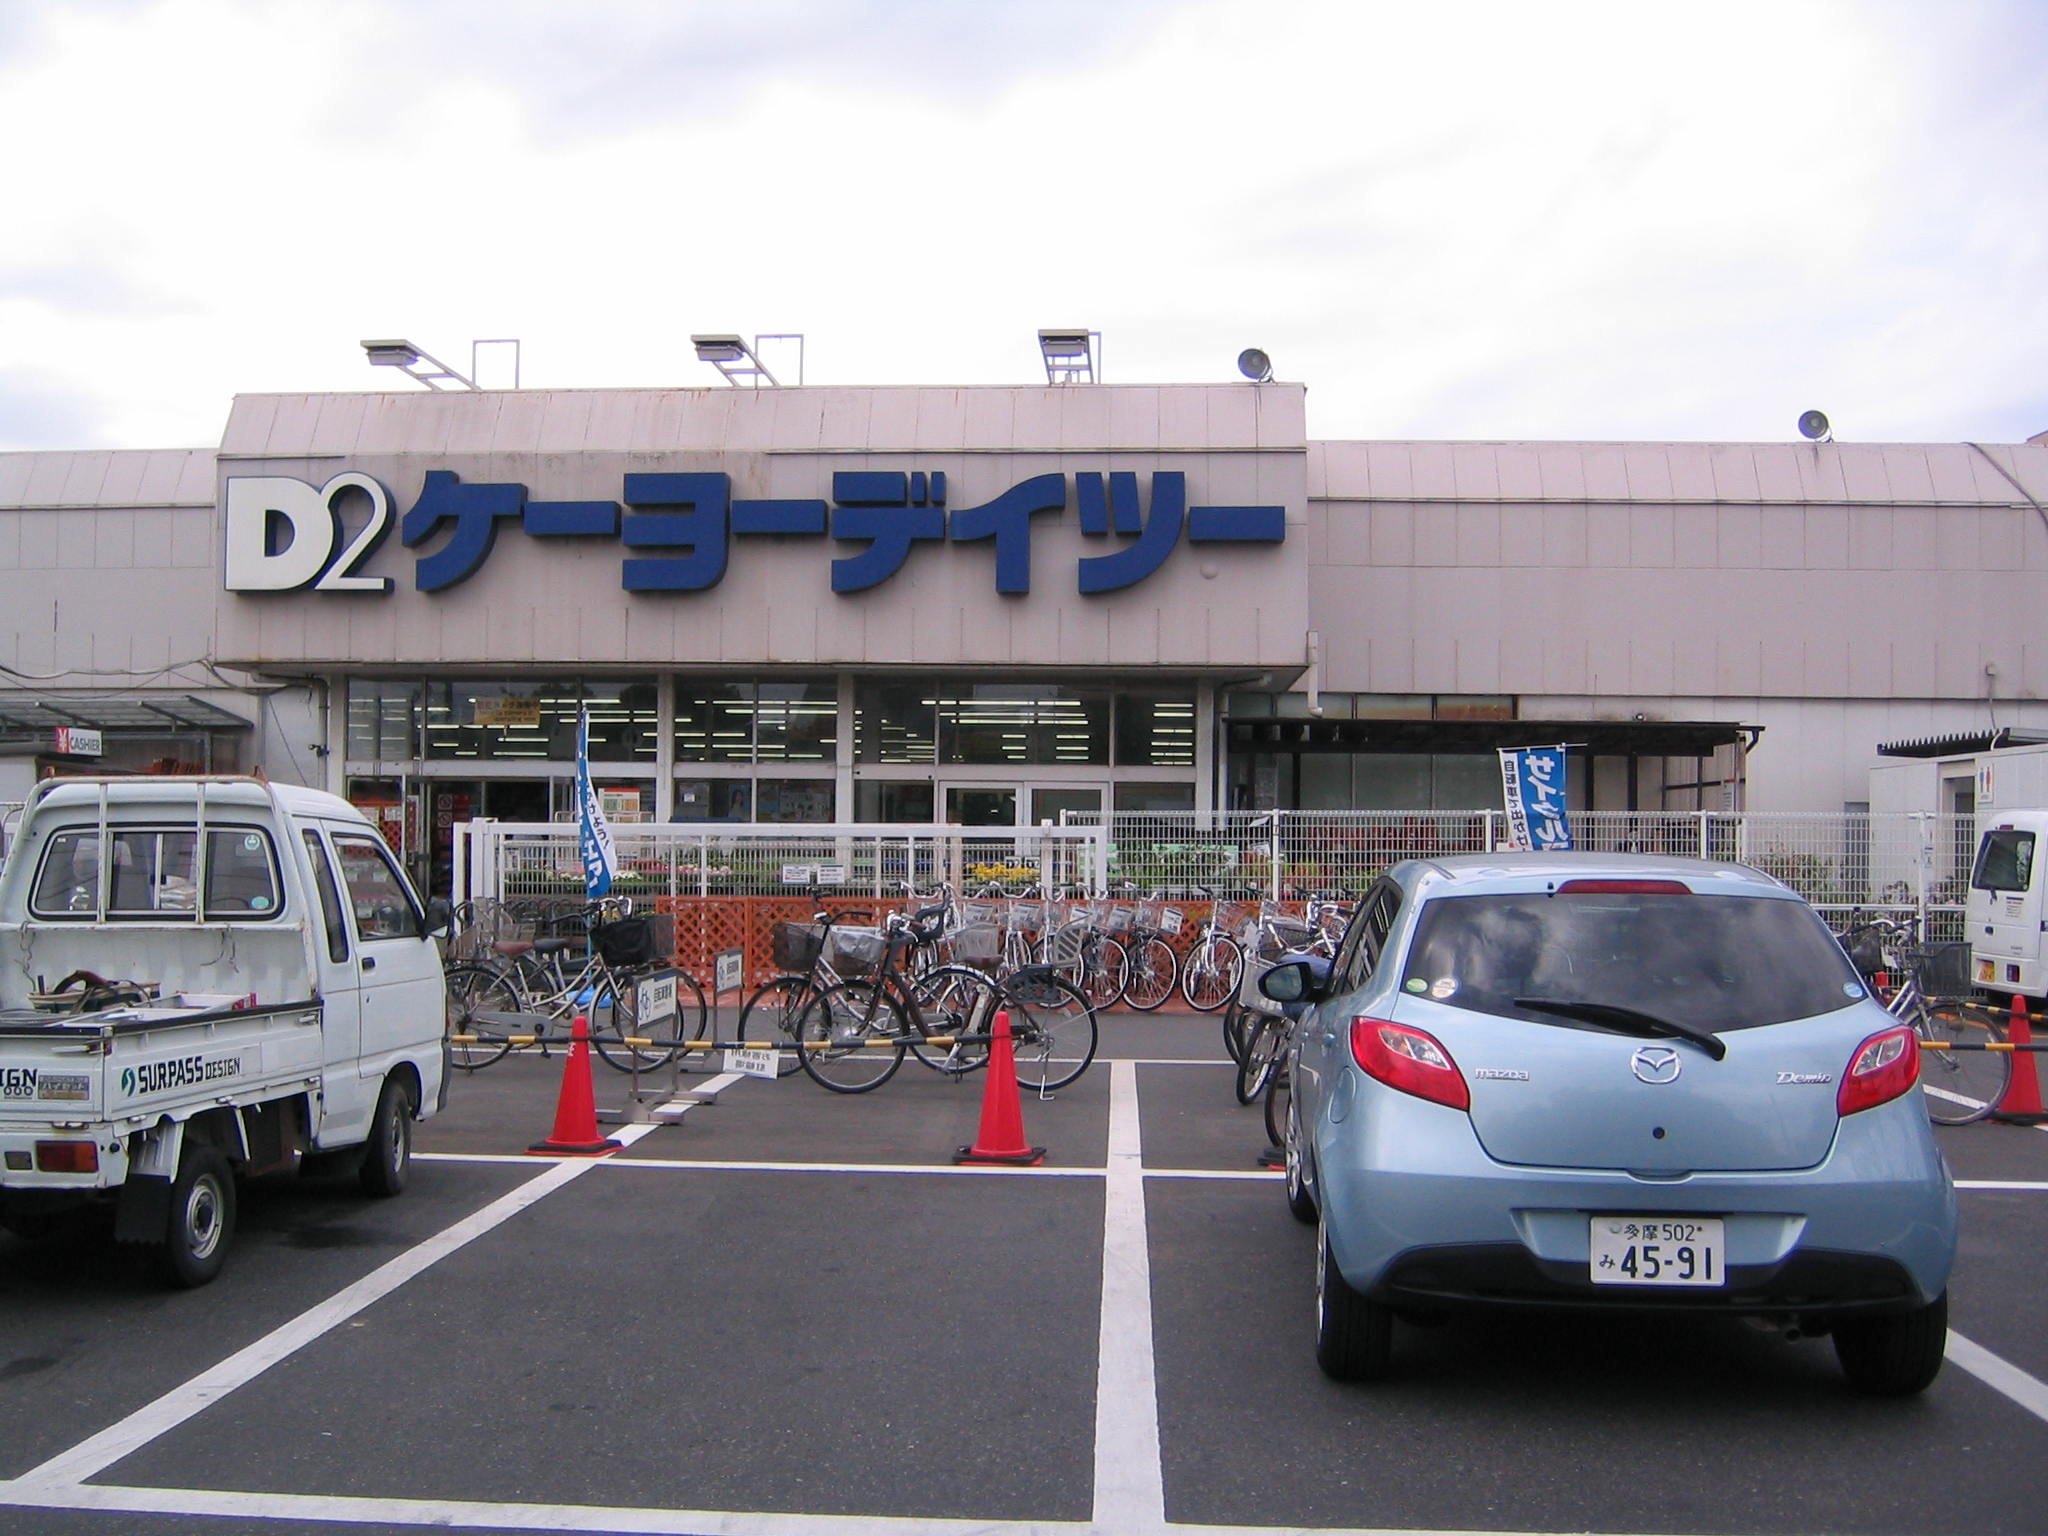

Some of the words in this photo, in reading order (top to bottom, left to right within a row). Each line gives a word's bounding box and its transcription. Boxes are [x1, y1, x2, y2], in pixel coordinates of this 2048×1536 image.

[225, 471, 397, 593] D2
[402, 469, 1287, 596] ケーヨーデイツー
[70, 736, 100, 751] CASHIER
[138, 1056, 204, 1094] SURPASS
[205, 1057, 241, 1080] DESIGN
[1475, 1068, 1529, 1081] mazda
[1623, 1223, 1658, 1241] 多摩
[1662, 1223, 1696, 1242] 502
[1599, 1254, 1616, 1269] み
[1620, 1245, 1712, 1280] 45-91
